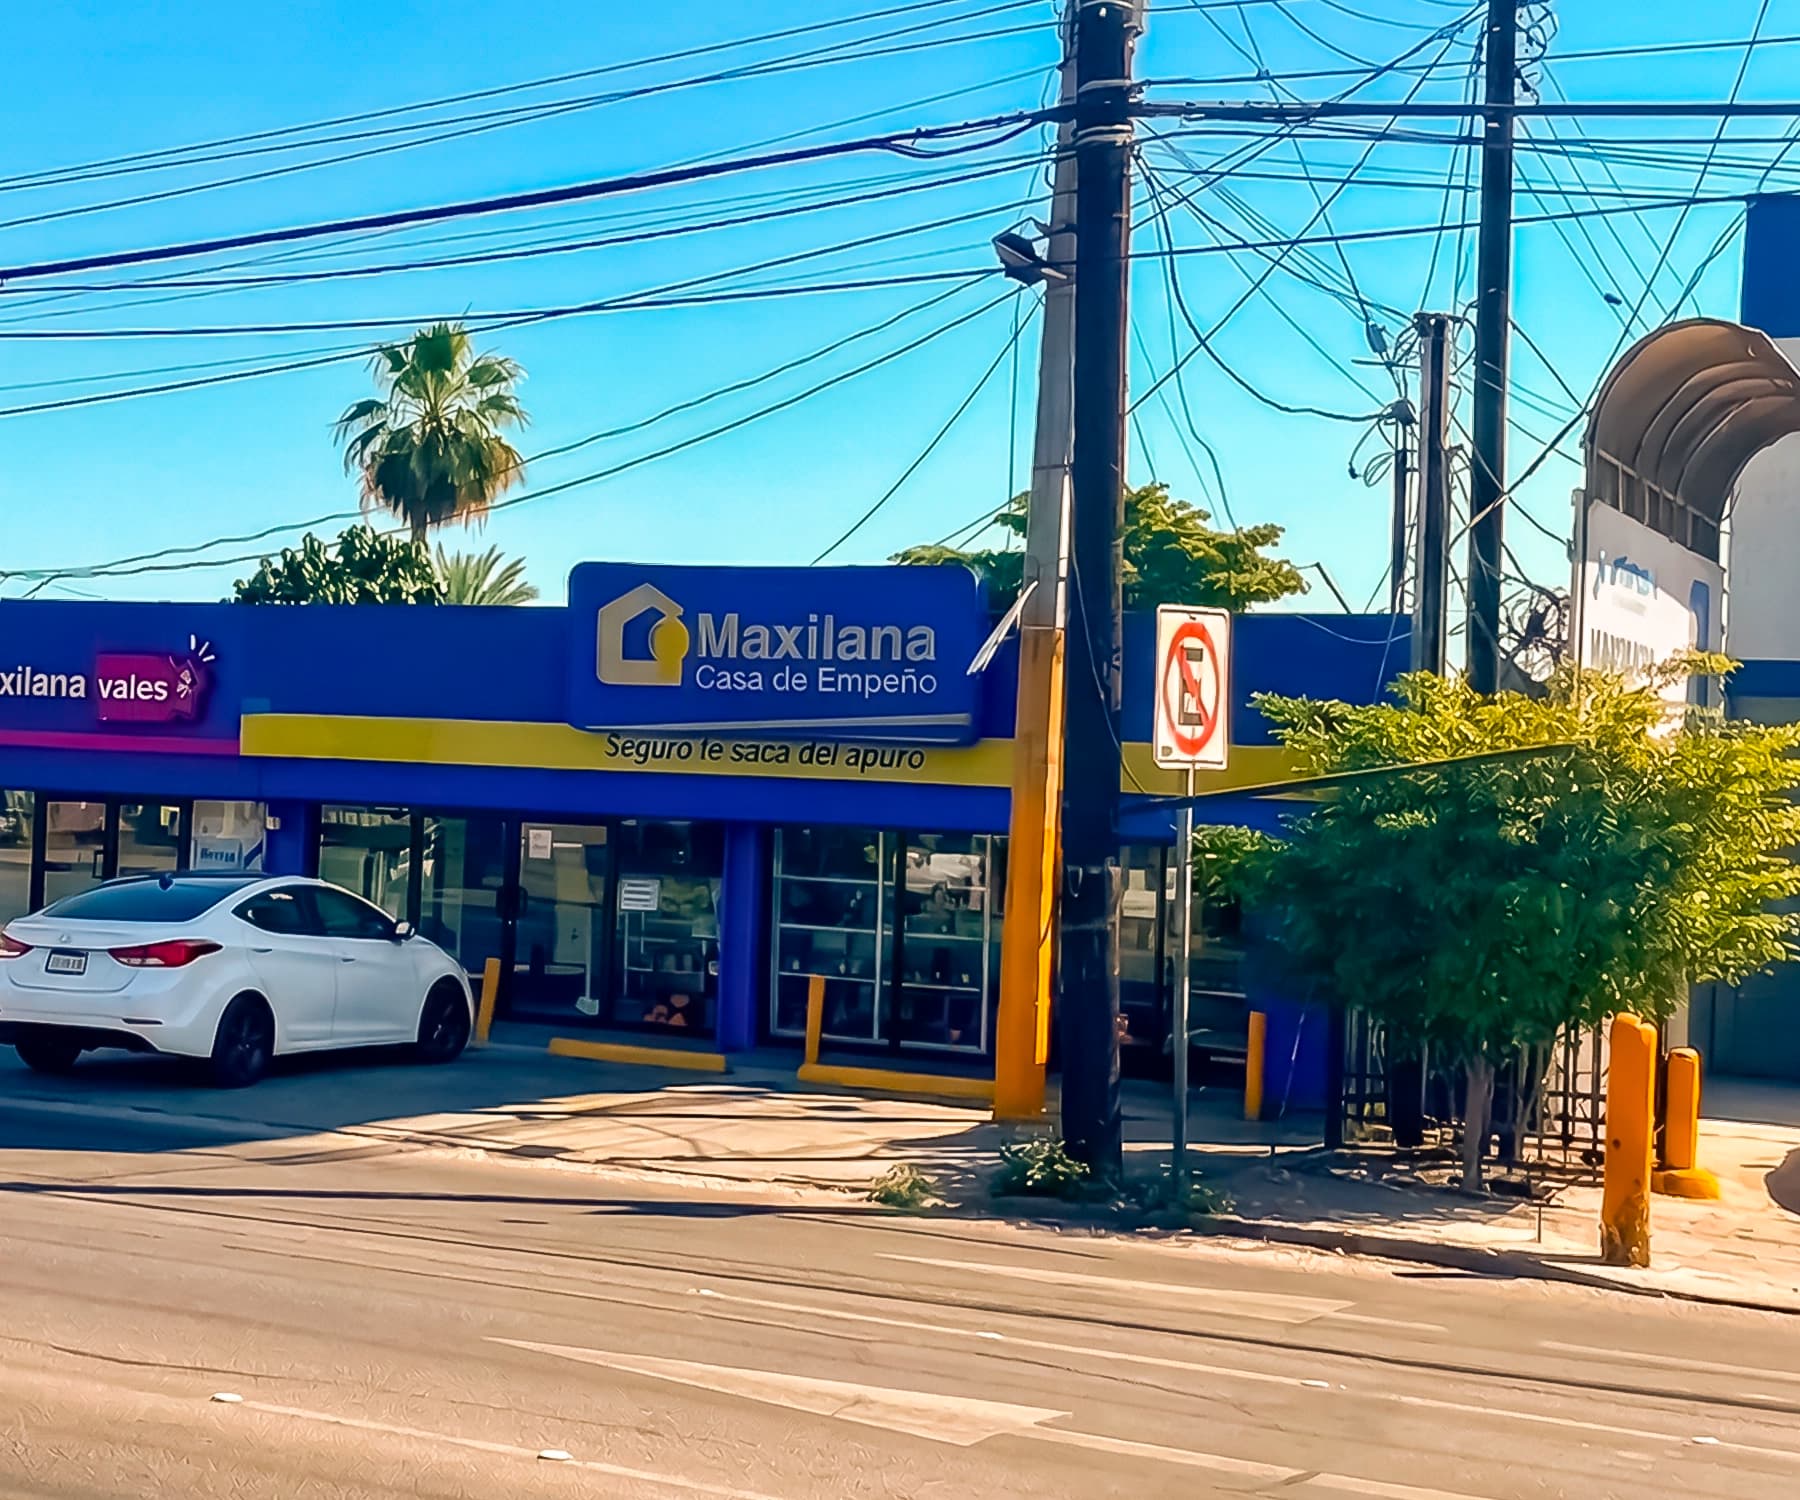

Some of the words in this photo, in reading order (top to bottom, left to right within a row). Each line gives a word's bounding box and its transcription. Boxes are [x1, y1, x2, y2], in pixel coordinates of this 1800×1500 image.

[697, 612, 937, 662] Maxilana
[98, 674, 168, 701] vales
[695, 664, 763, 691] Casa
[772, 665, 808, 692] de
[817, 667, 938, 699] Empeño
[604, 732, 693, 765] Seguro
[730, 742, 791, 764] saca
[798, 741, 840, 766] del
[845, 747, 925, 774] apuro
